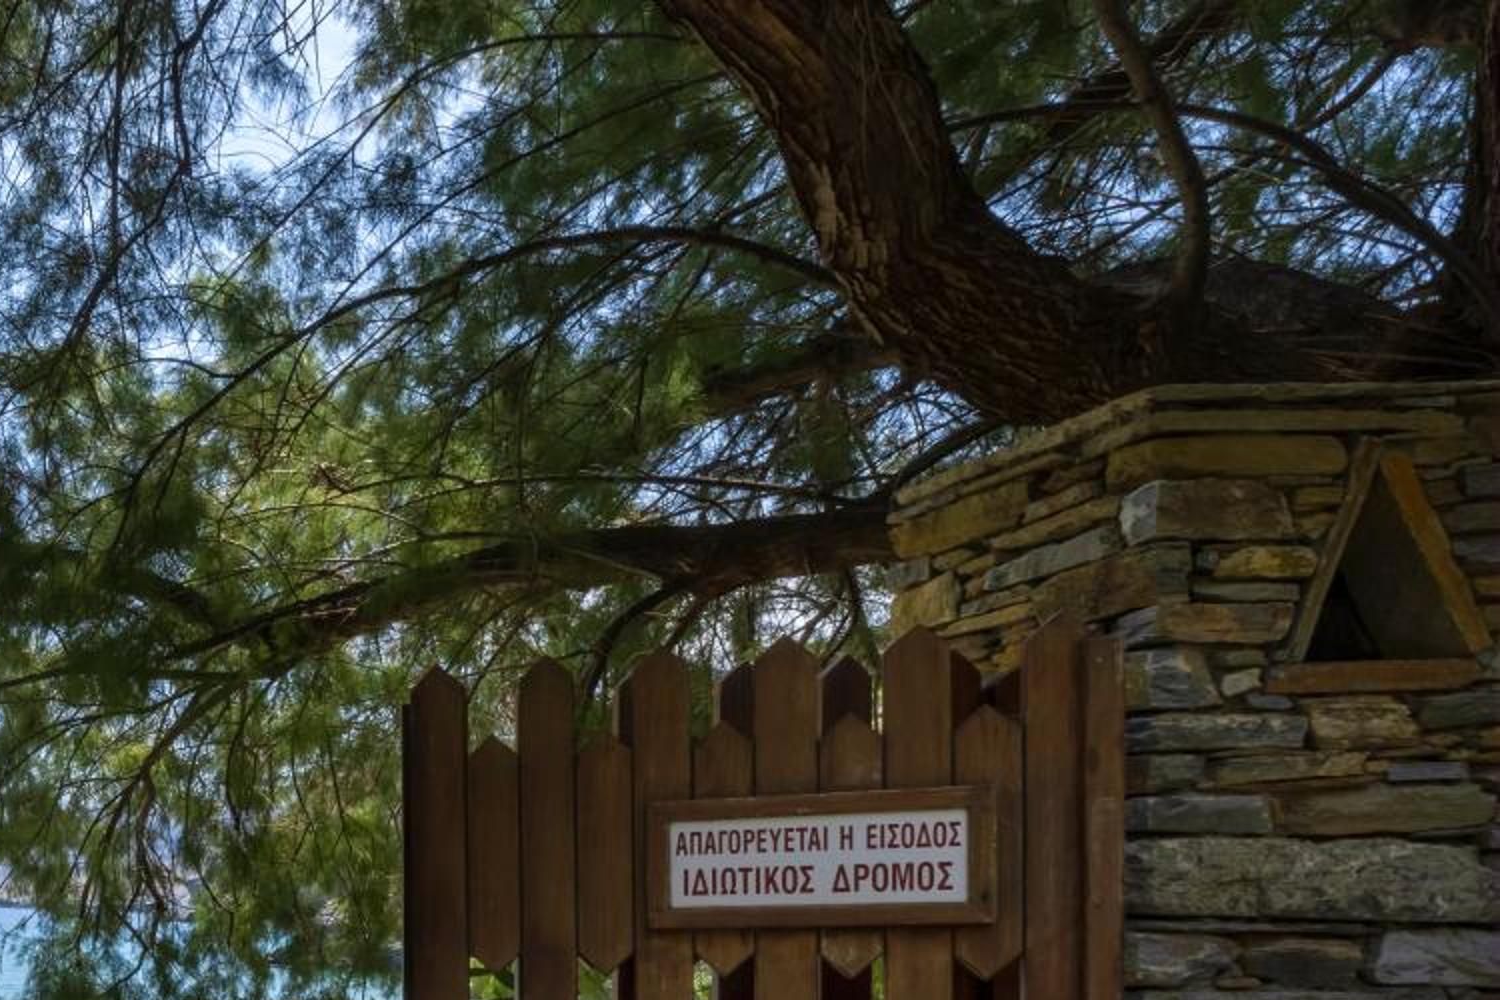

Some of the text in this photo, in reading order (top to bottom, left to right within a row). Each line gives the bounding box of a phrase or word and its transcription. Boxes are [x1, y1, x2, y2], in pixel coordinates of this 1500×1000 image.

[675, 821, 962, 856] ΑΠΑΓΟΡΕΥΕΤΑΙ Η ΕΙΣΟΔΟΣ
[683, 861, 954, 897] ΙΔΙΩΤΙΚΟΣ ΔΡΟΜΟΣ
